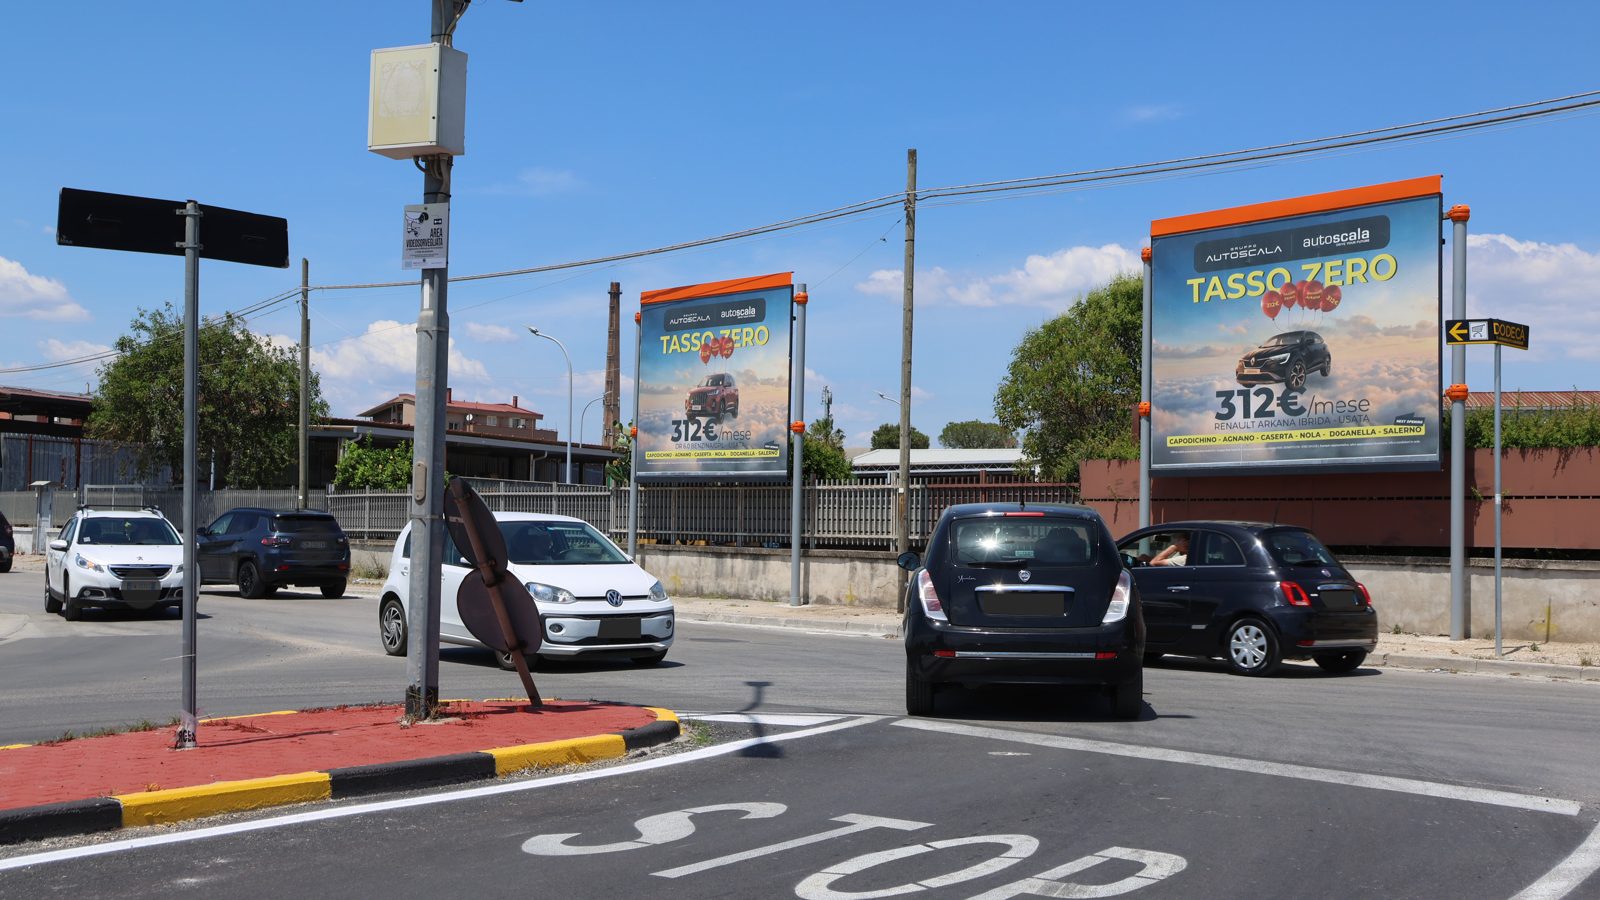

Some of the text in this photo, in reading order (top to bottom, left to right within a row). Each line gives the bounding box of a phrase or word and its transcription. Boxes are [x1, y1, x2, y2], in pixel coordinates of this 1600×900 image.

[430, 228, 443, 237] AREA
[1302, 227, 1370, 248] autoscala
[1205, 245, 1283, 263] AUTOSCALA
[1186, 253, 1398, 304] TASSO ZERO
[660, 331, 715, 354] TASSO
[1214, 414, 1370, 431] RENAULT ARKANA IBRIDA USATA
[1169, 436, 1217, 445] CAPODICHINO
[1222, 435, 1255, 443] AGNANO
[1260, 433, 1294, 441] CASERTA
[1300, 431, 1321, 439] NOLA
[1383, 426, 1422, 435] SALERNO
[521, 801, 1188, 900] STOP
